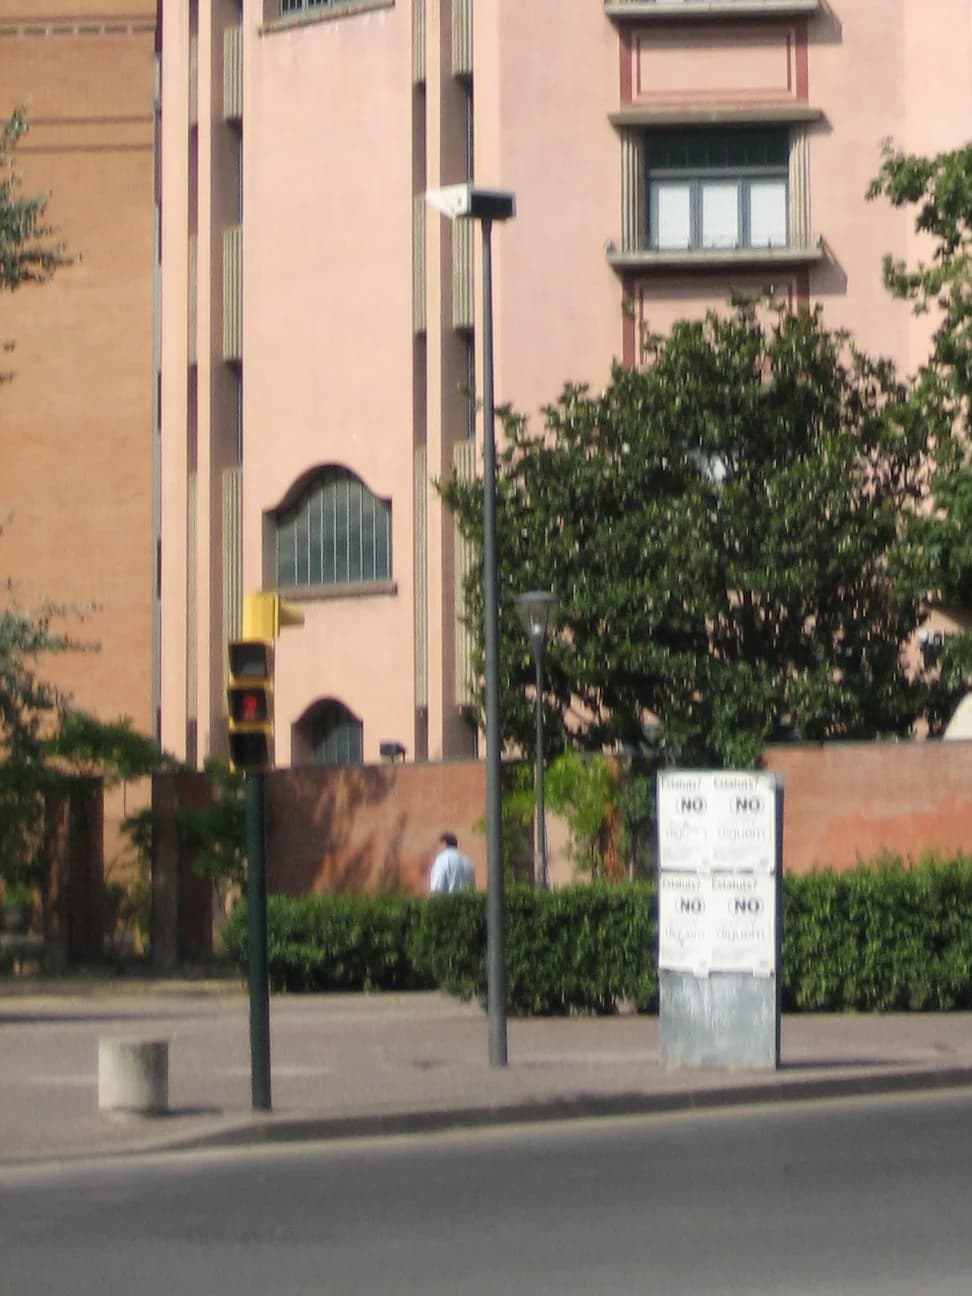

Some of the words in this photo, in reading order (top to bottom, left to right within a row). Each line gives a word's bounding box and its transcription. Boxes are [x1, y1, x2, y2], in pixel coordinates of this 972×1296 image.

[680, 796, 704, 814] NO
[736, 795, 761, 814] NO
[680, 896, 702, 914] NO
[735, 895, 760, 914] NO
